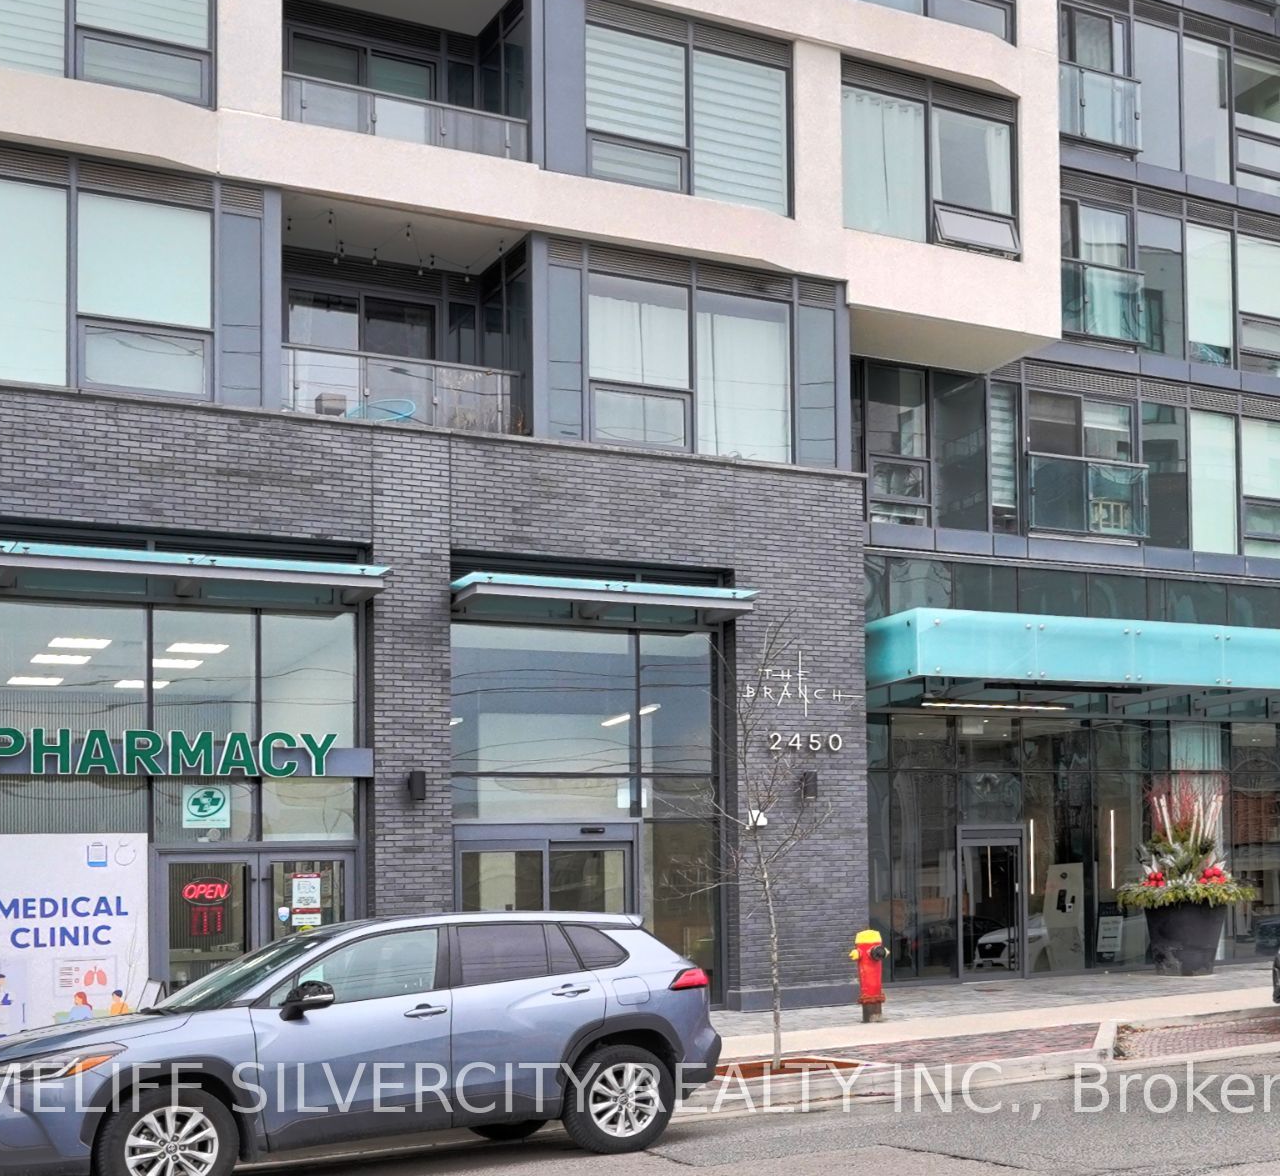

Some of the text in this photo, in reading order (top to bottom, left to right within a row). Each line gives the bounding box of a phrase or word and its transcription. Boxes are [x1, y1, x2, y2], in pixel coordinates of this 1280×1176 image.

[759, 651, 811, 682] THE
[741, 682, 864, 717] BRANCH
[769, 732, 842, 751] 2450
[183, 883, 229, 900] OPEN
[10, 925, 112, 949] CLINIC
